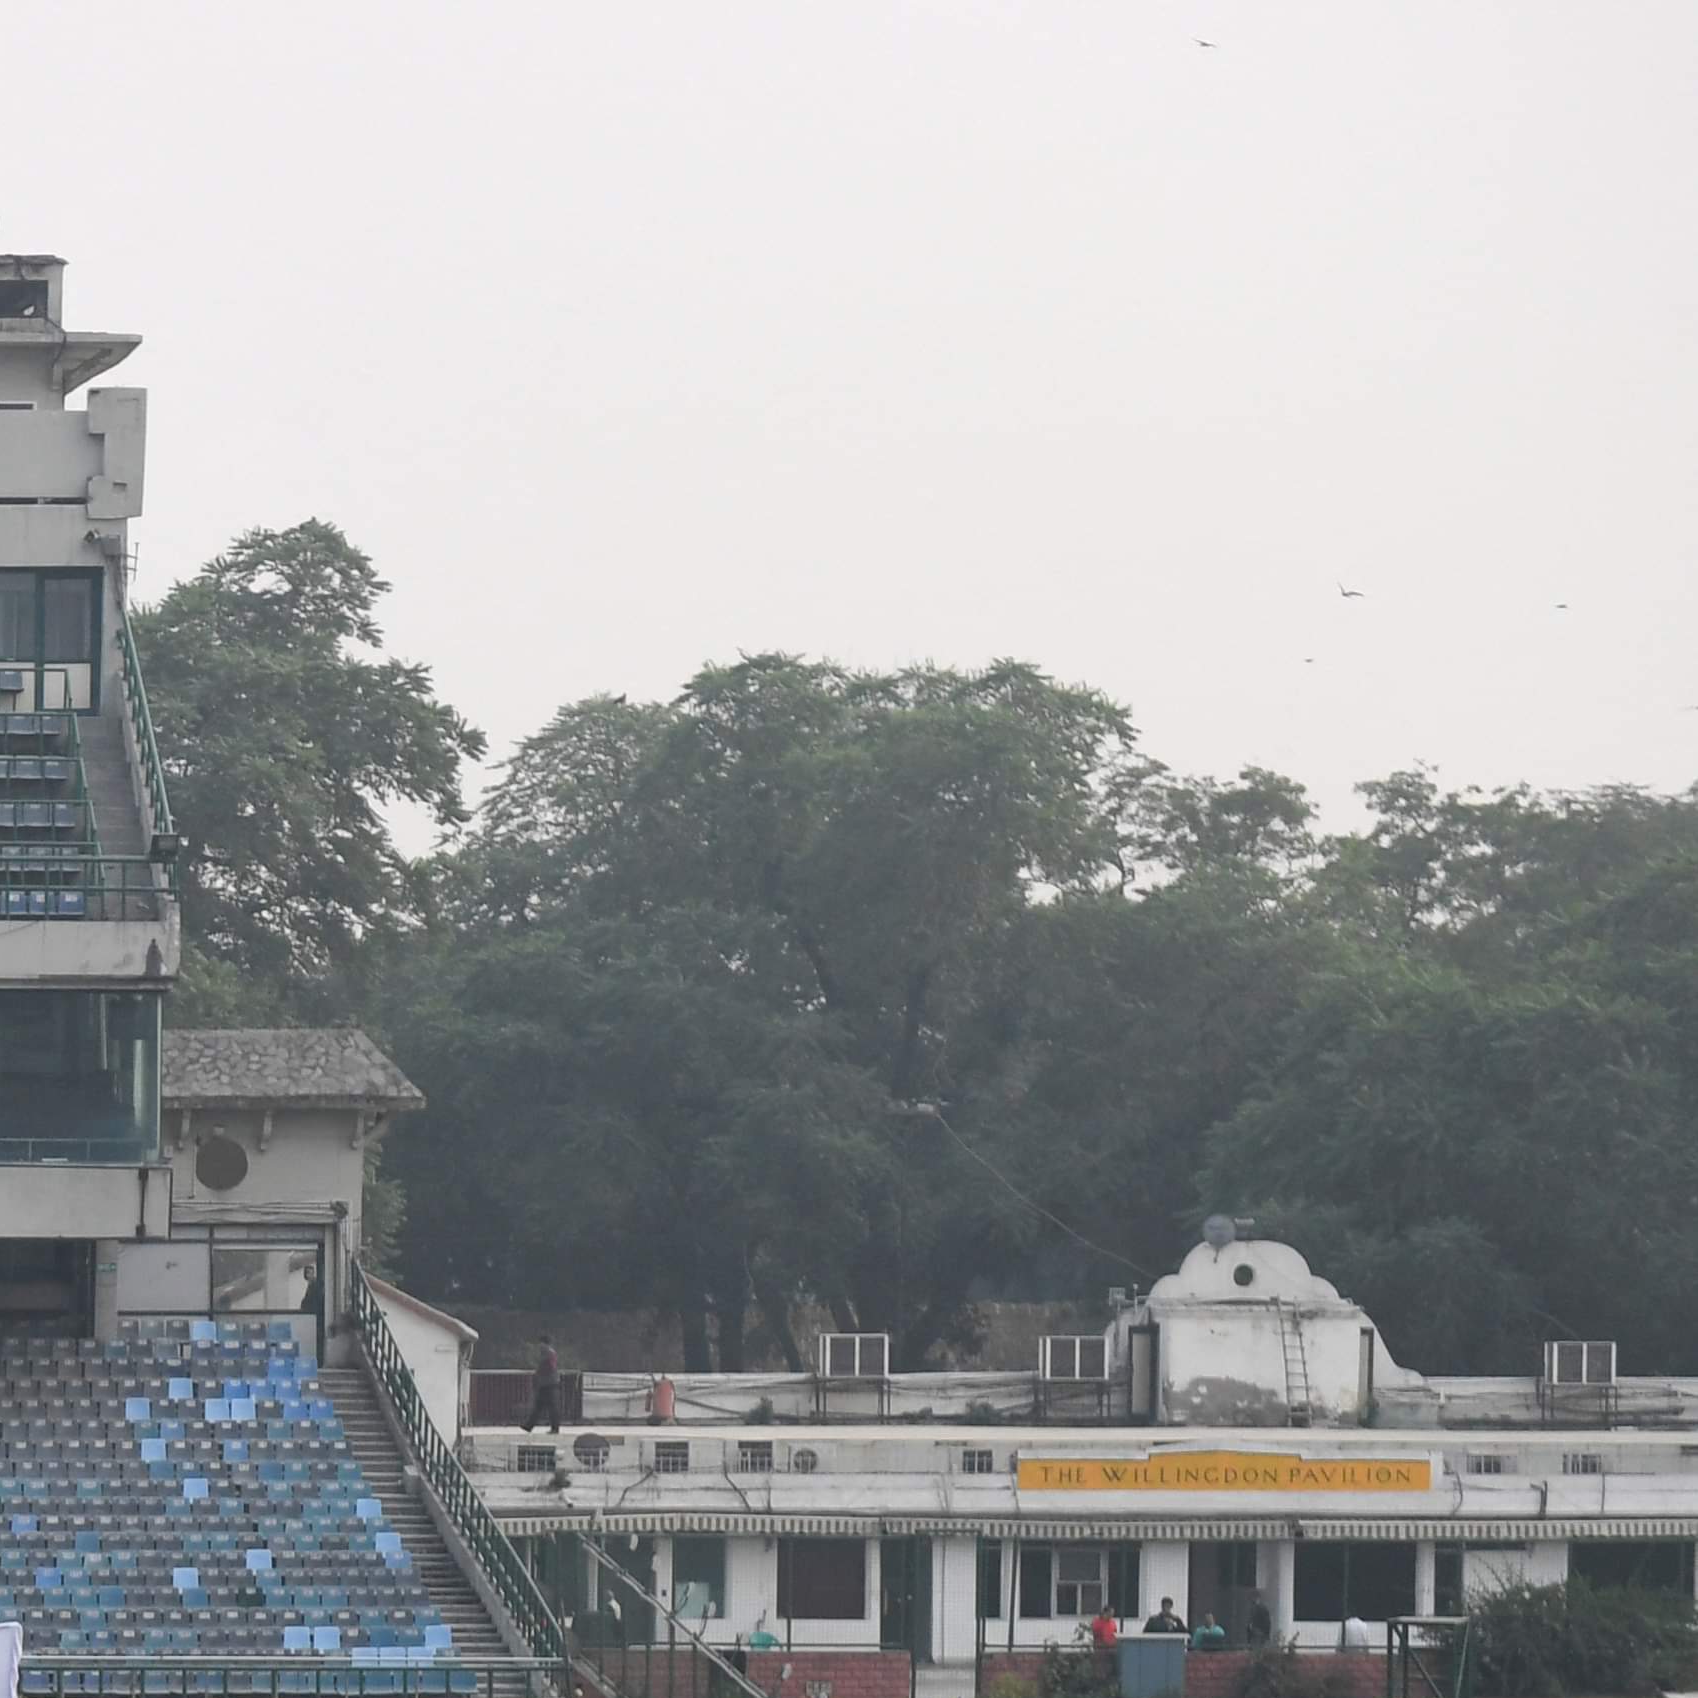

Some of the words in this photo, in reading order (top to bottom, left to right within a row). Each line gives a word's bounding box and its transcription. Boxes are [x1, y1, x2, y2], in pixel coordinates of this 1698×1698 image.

[1039, 1466, 1087, 1483] THE
[1102, 1466, 1278, 1484] WILLINGDON
[1289, 1466, 1411, 1484] PAVILION
